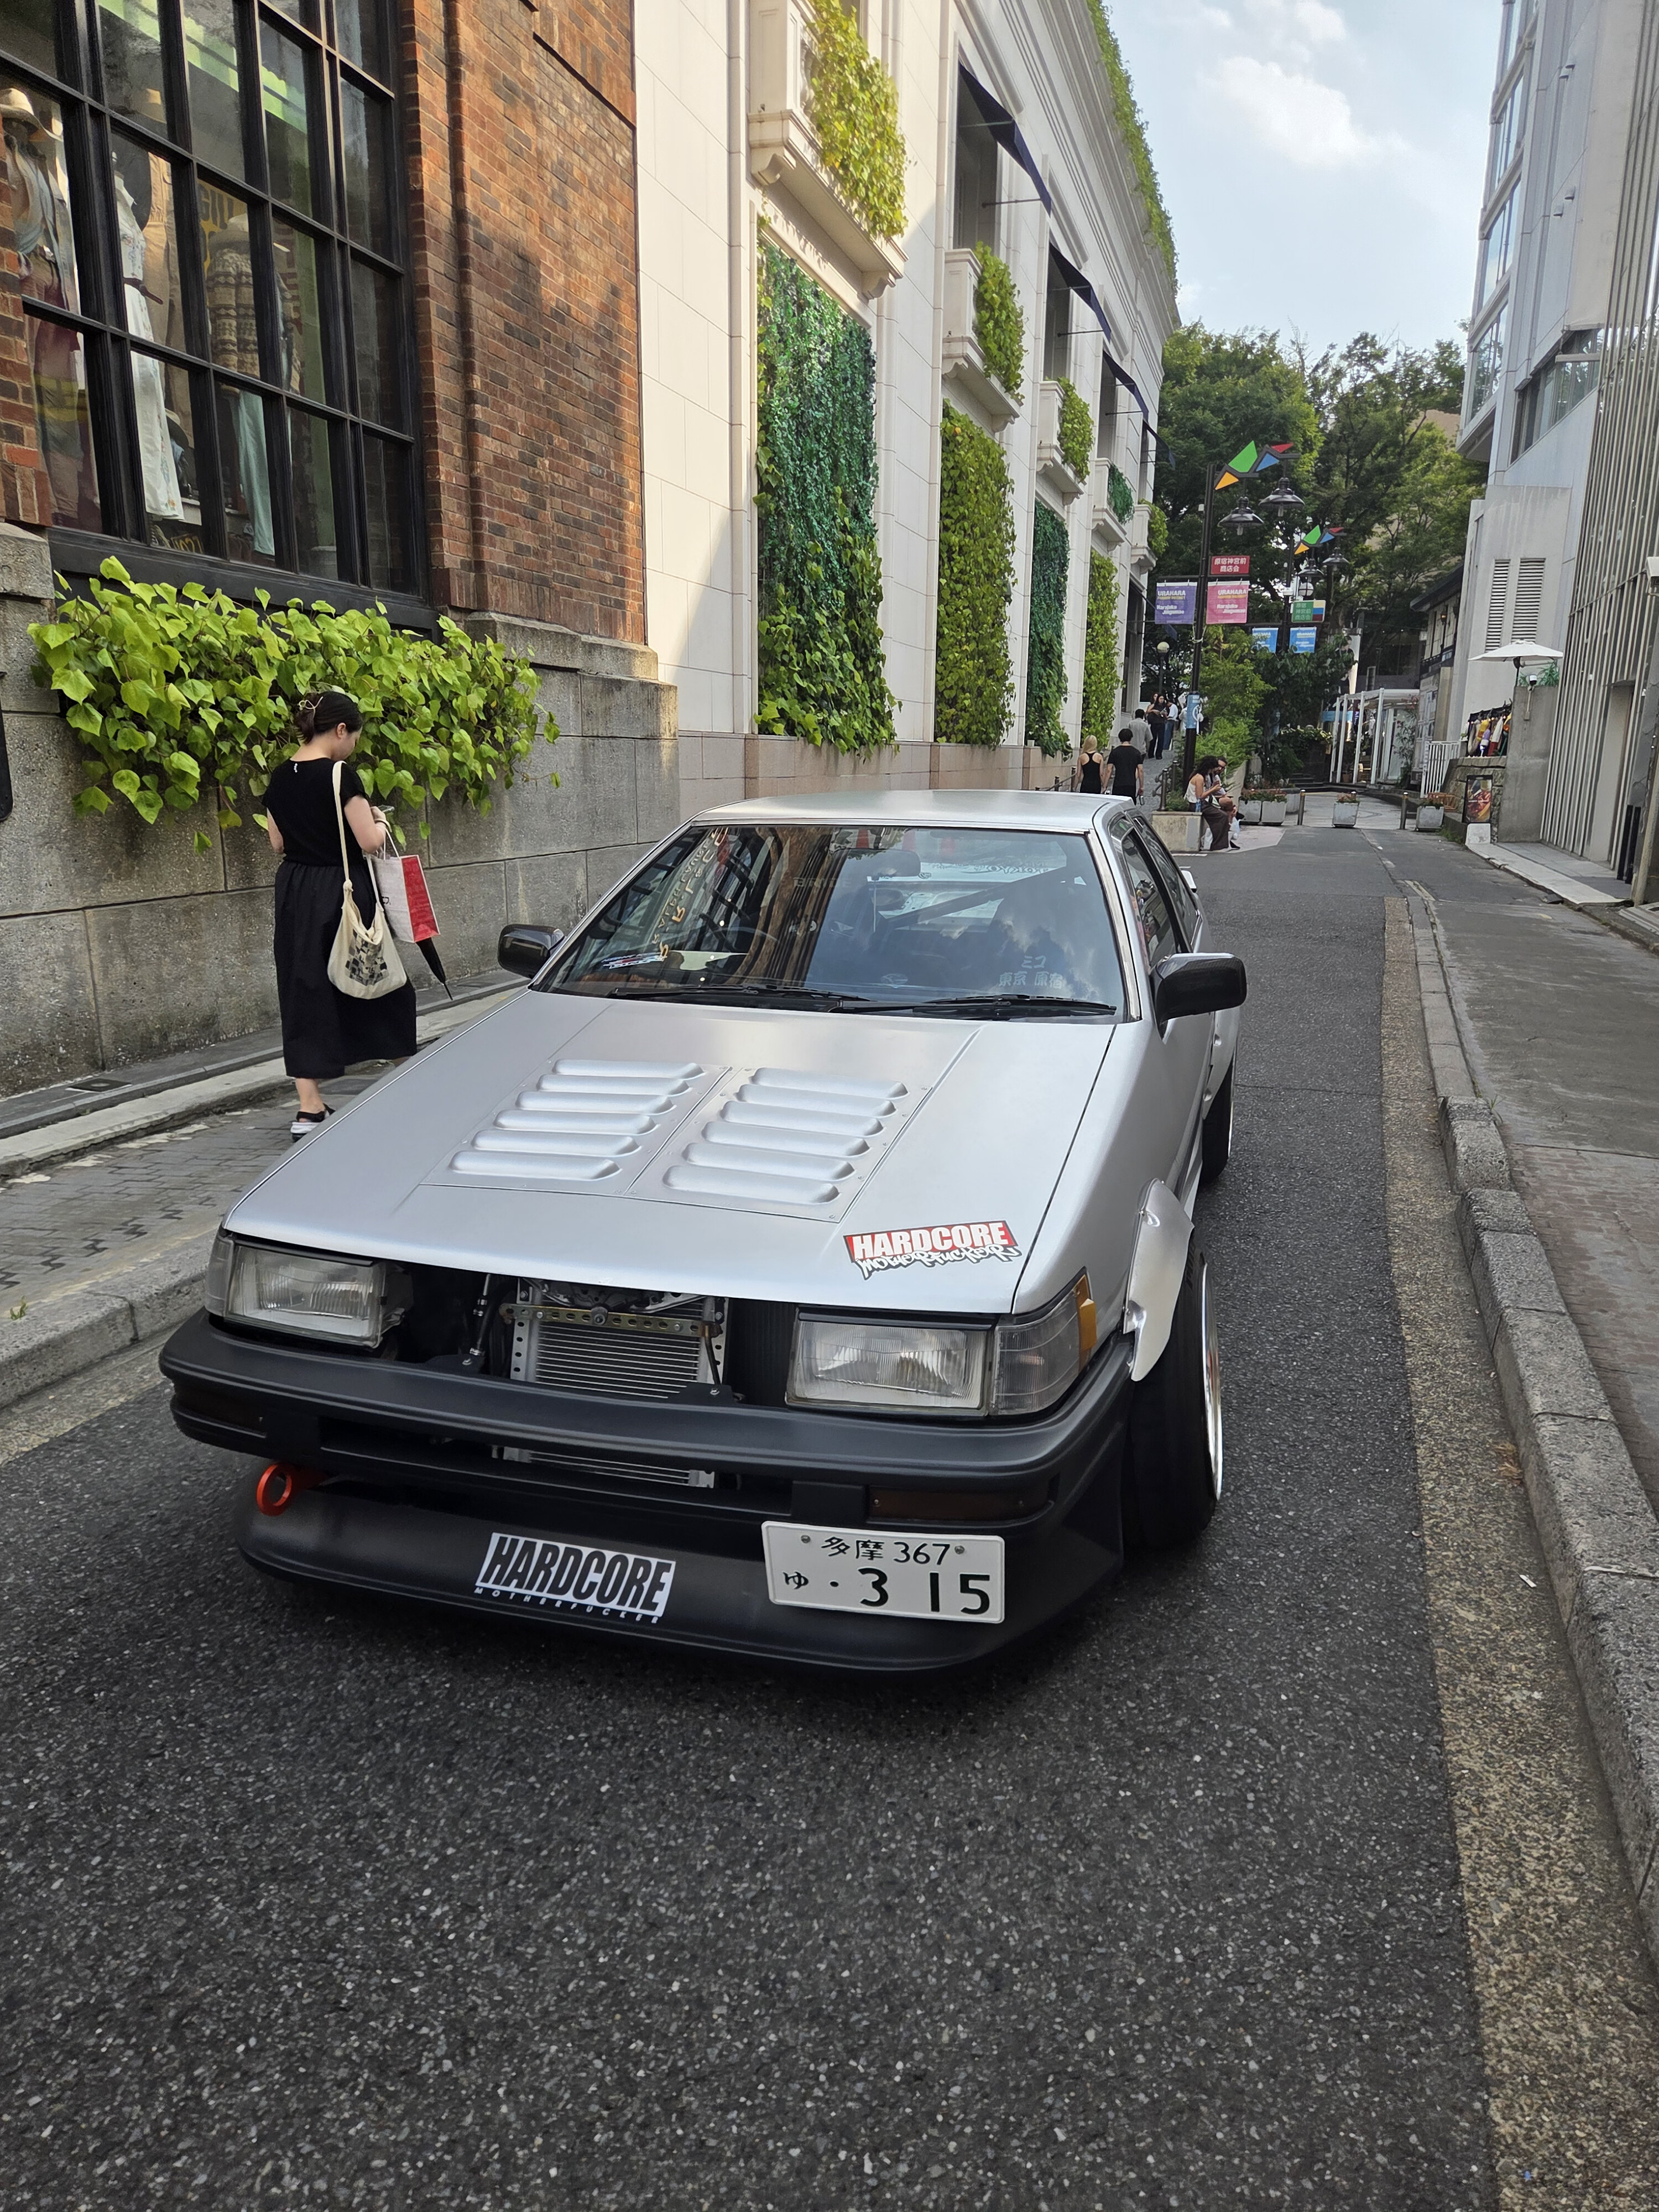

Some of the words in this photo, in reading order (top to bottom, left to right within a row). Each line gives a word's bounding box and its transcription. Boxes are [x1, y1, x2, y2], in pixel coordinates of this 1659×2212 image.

[999, 971, 1027, 987] 東京
[852, 1222, 1009, 1260] HARDCORE
[821, 1536, 885, 1561] 多摩
[893, 1541, 951, 1566] 367
[481, 1536, 672, 1612] HARDCORE
[782, 1571, 809, 1589] ゆ
[474, 1587, 659, 1624] MOTHERFUCKER
